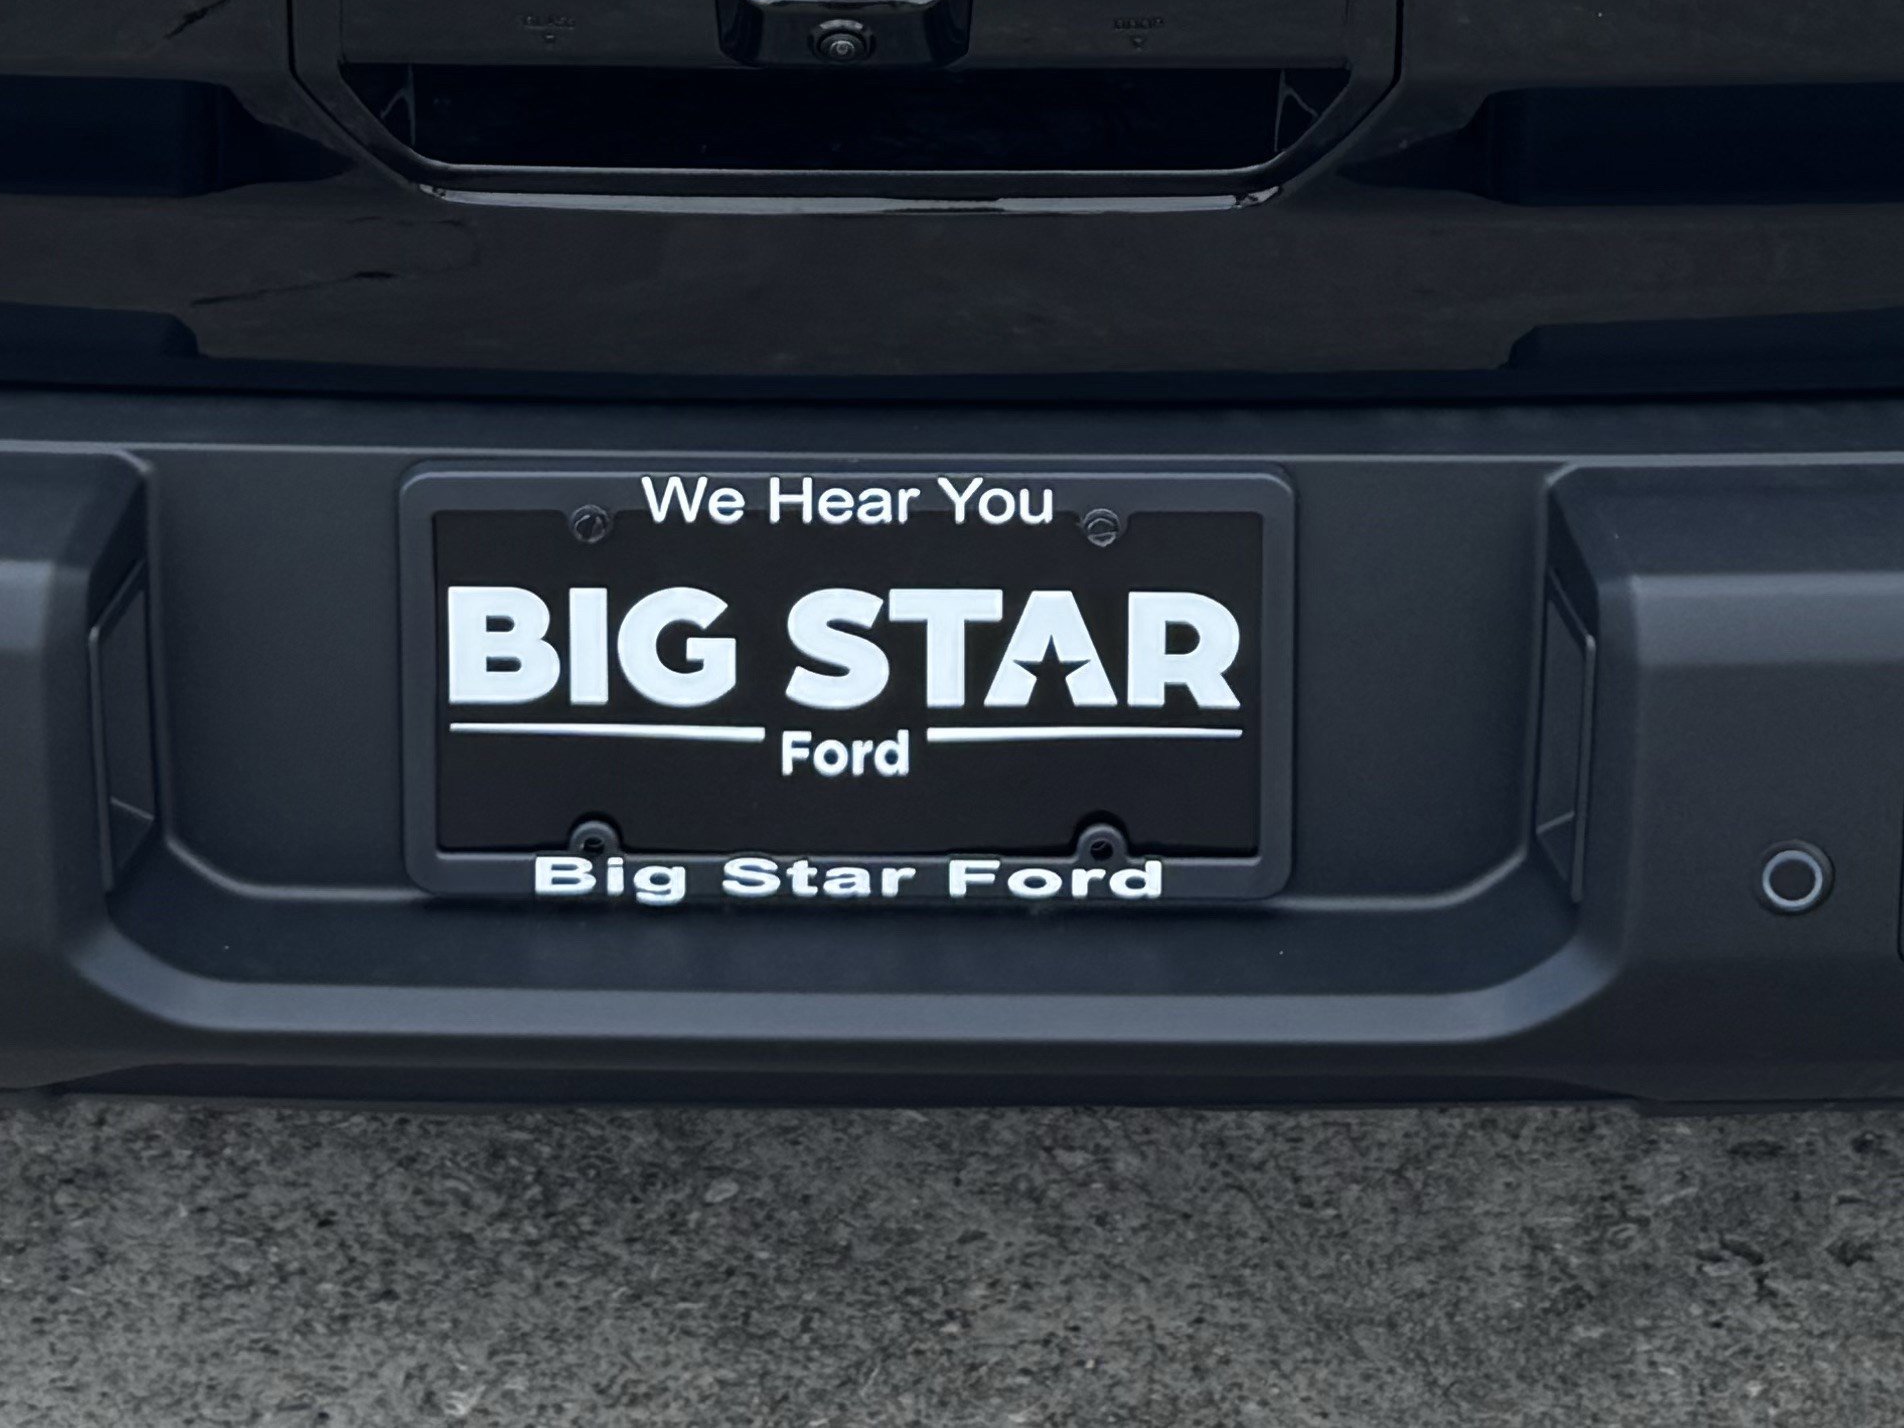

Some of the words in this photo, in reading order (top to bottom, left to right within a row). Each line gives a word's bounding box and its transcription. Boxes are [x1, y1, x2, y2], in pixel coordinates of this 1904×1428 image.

[641, 474, 746, 524] We
[769, 474, 921, 525] Hear
[937, 474, 1053, 525] You
[447, 585, 737, 708] BIG
[785, 587, 1242, 710] STAR
[781, 729, 910, 776] Ford
[534, 856, 686, 904] Big
[722, 857, 917, 897] Star
[948, 859, 1163, 898] Ford
